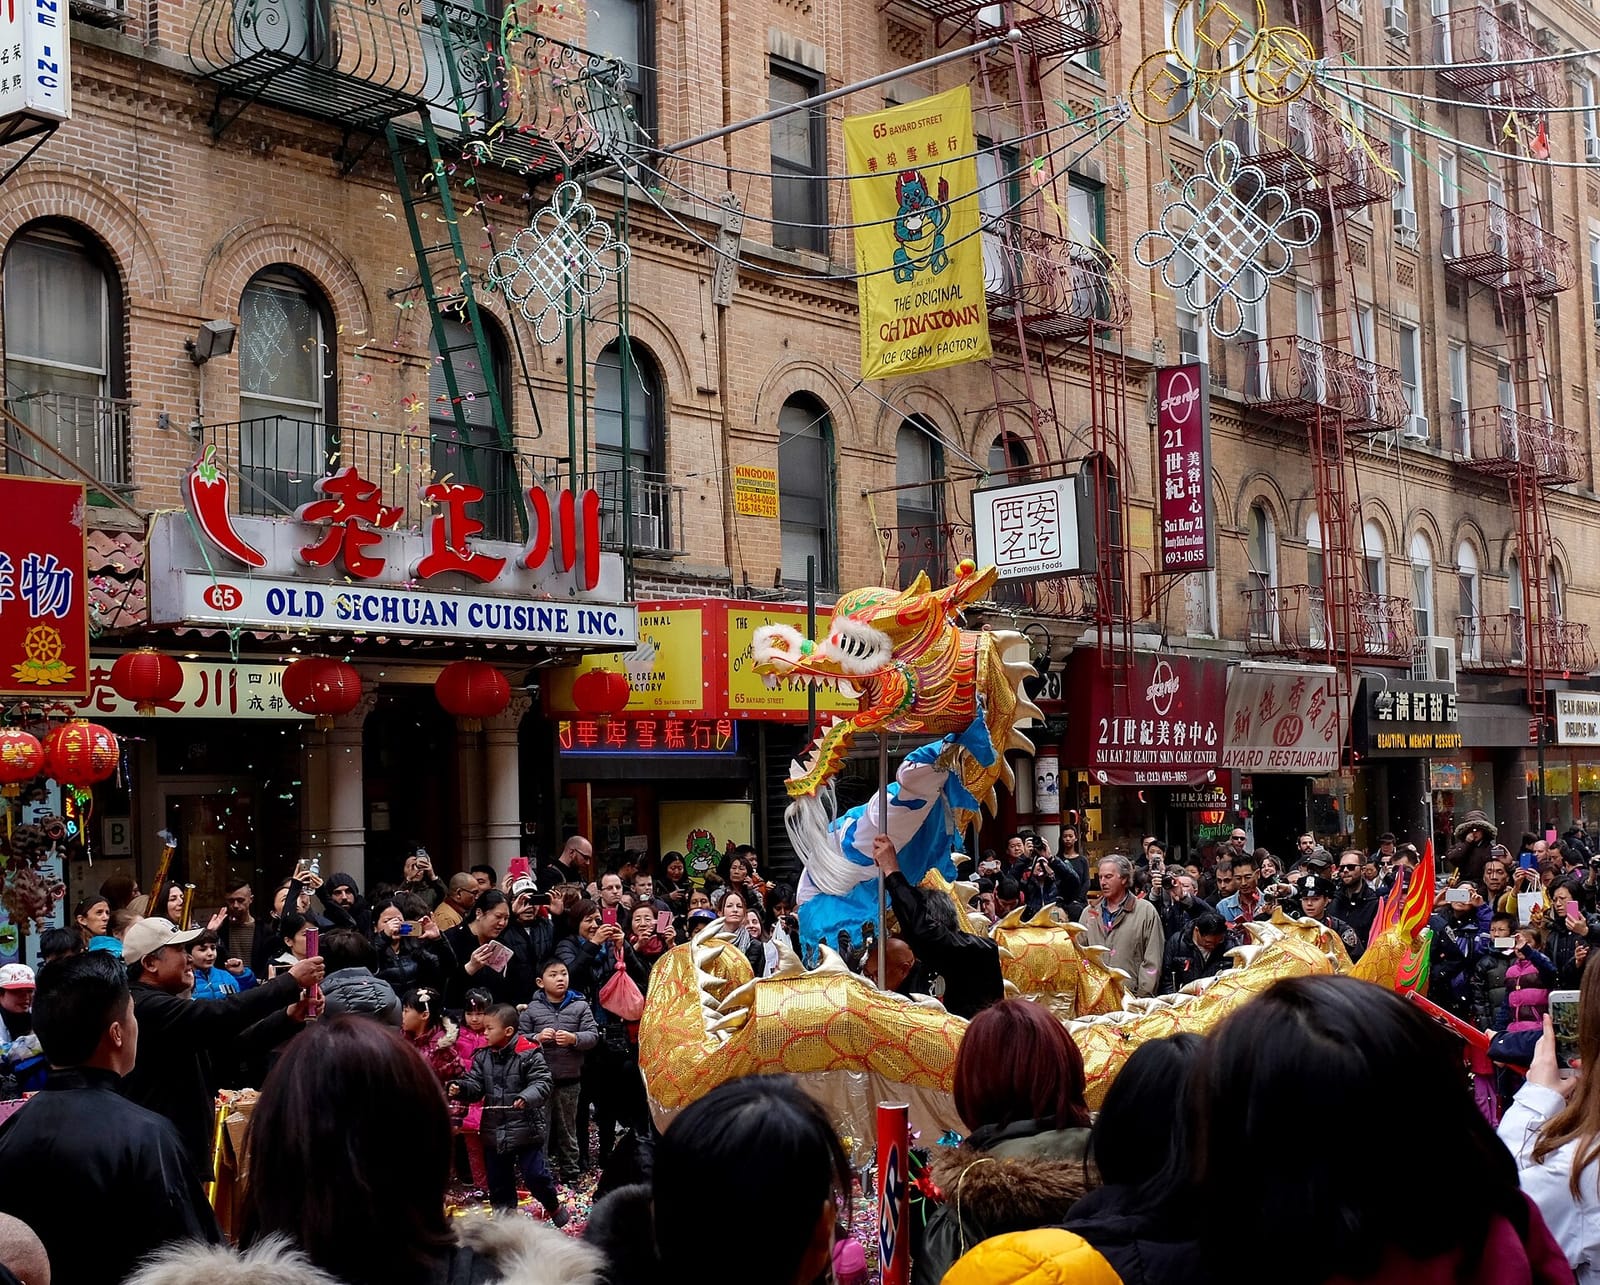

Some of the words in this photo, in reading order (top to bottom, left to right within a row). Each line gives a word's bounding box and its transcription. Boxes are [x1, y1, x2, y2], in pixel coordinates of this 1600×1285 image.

[873, 123, 887, 139] 65
[889, 121, 917, 136] BAYARD
[918, 114, 942, 129] STREET
[894, 295, 911, 313] THE
[914, 284, 963, 308] ORIGINAL
[880, 304, 980, 342] CHINATOWN
[882, 351, 897, 365] ICE
[900, 345, 932, 362] CREAM
[937, 336, 978, 356] FACTORY
[736, 466, 776, 481] KINGDOM
[1187, 451, 1201, 514] 美容中心
[997, 495, 1056, 532] 西安
[298, 467, 601, 592] 老正川
[1165, 519, 1177, 533] Sai
[1179, 518, 1193, 533] Kay
[1195, 516, 1203, 530] 21
[1000, 526, 1057, 560] 名吃
[1165, 549, 1204, 564] 693-1055
[1013, 564, 1040, 574] Famous
[1042, 561, 1062, 570] Foods
[211, 588, 236, 608] 65
[266, 588, 324, 617] OLD
[337, 592, 458, 627] SICHUAN
[468, 603, 568, 633] CUISINE
[578, 610, 624, 636] INC.
[736, 617, 748, 629] THE
[636, 672, 666, 681] CREAM
[630, 683, 662, 692] ACTORY
[248, 694, 300, 712] 成都
[735, 693, 745, 704] 65
[1277, 717, 1300, 746] 69
[1377, 733, 1407, 748] BEAUTIFUL
[1409, 734, 1433, 748] MEMORY
[1435, 734, 1462, 748] DESSERTS
[1096, 749, 1109, 763] SAI
[1110, 749, 1124, 763] KAY
[1125, 750, 1131, 763] 21
[1133, 750, 1158, 763] BEAUTY
[1160, 751, 1174, 763] SKIN
[1175, 751, 1192, 763] CARE
[1194, 751, 1217, 763] CENTER
[1222, 750, 1263, 767] AYARD
[1267, 751, 1337, 768] RESTAURANT
[111, 823, 125, 845] B
